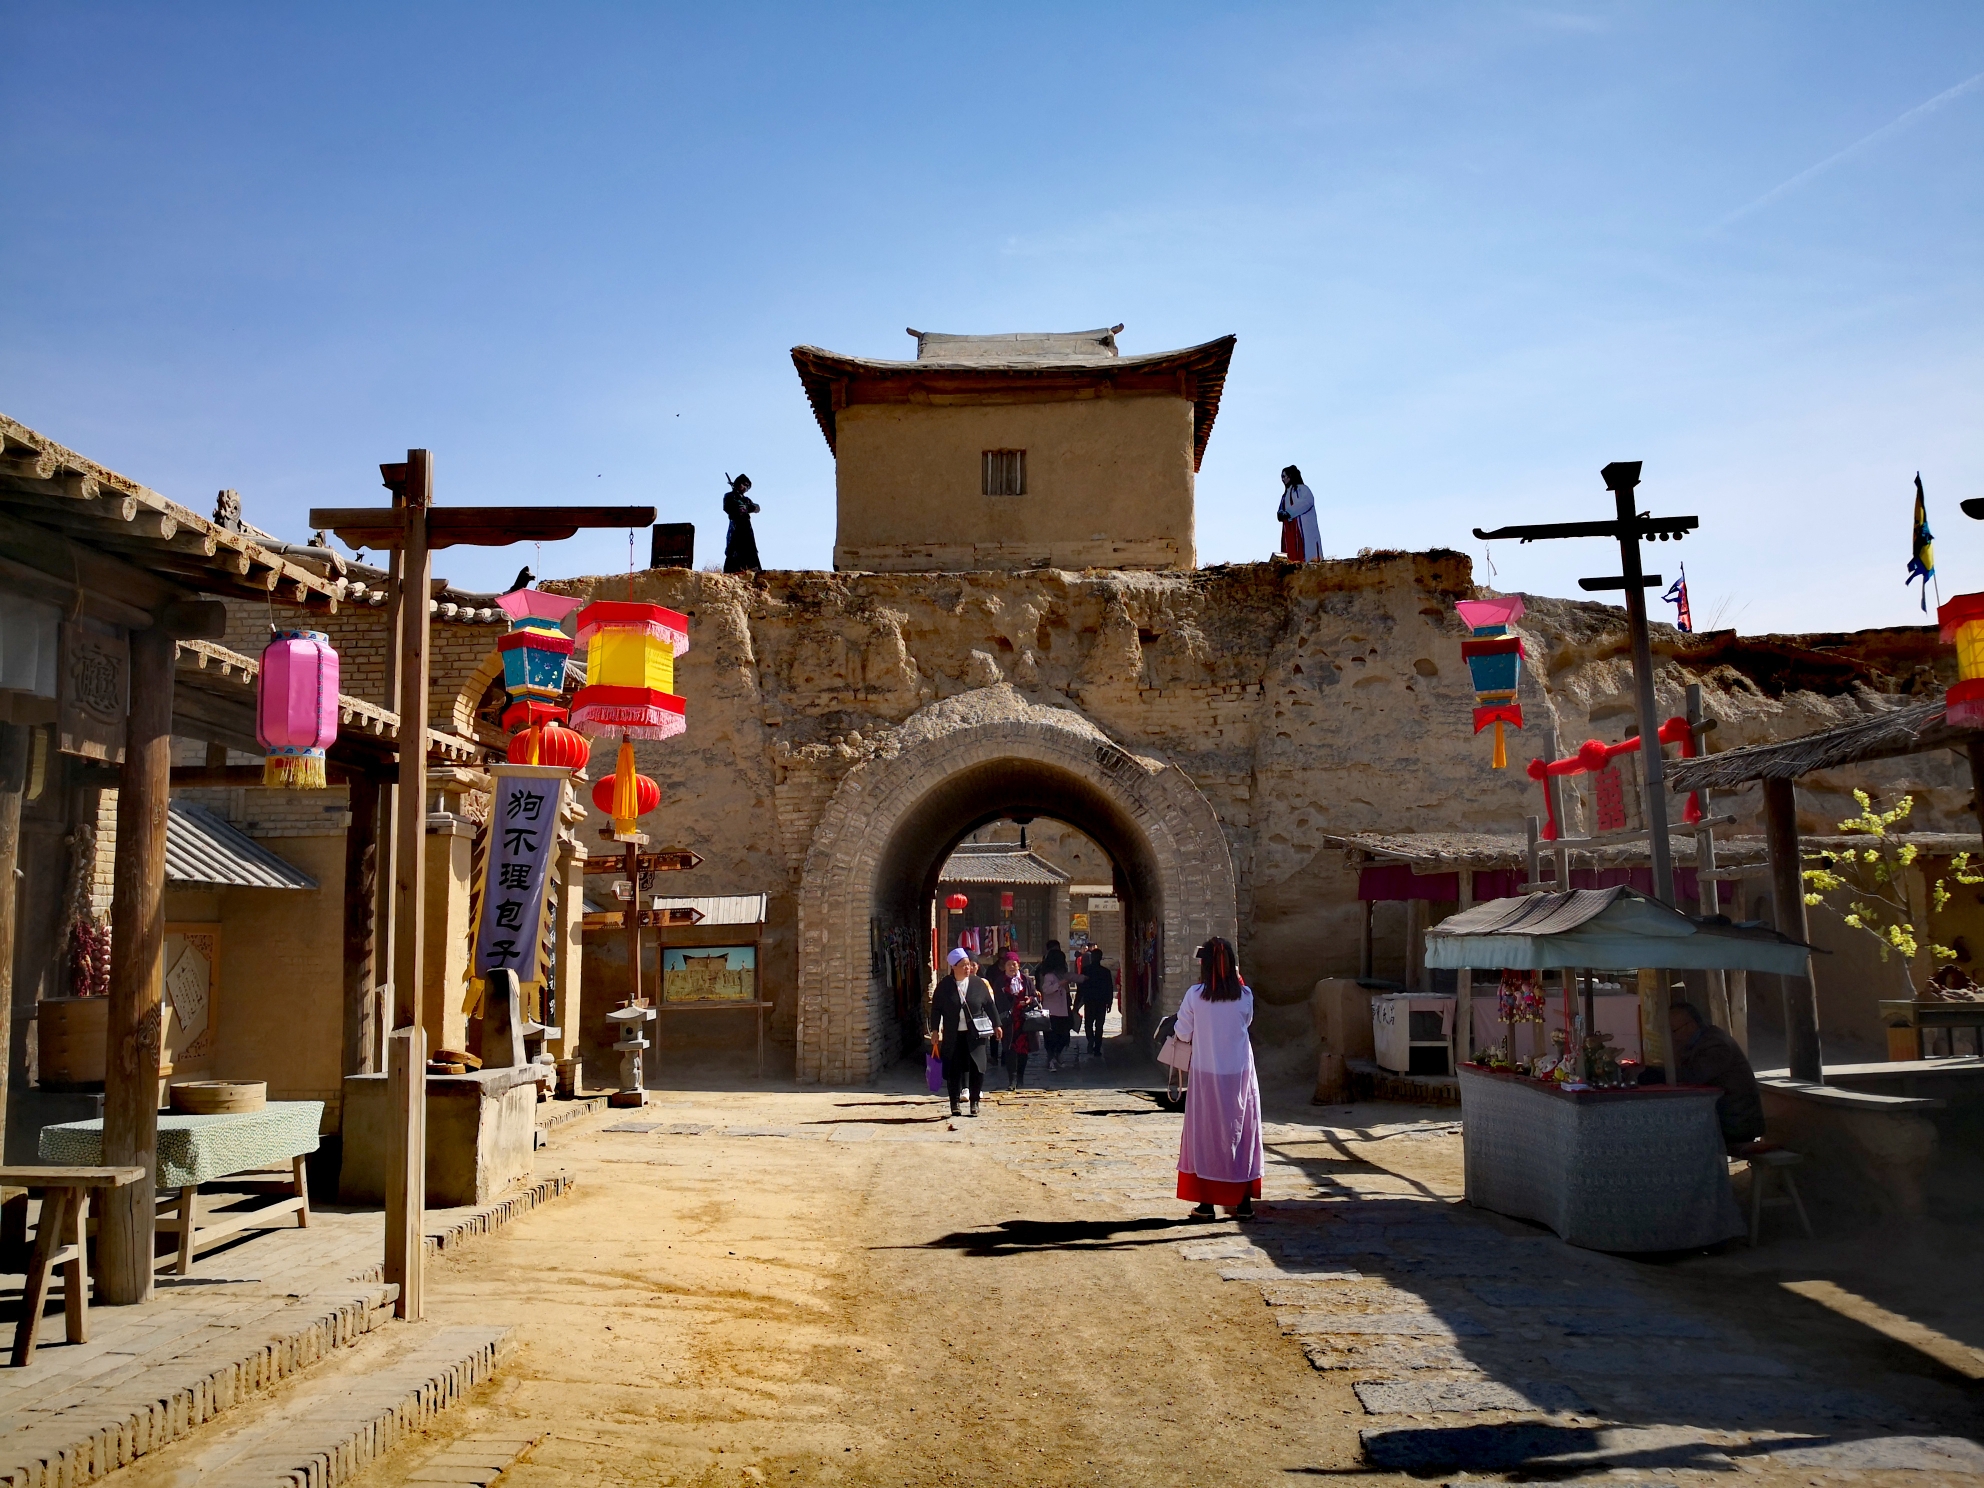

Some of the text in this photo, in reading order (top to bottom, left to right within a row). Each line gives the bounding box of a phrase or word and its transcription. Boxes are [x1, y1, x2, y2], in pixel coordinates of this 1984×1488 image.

[486, 789, 545, 969] 狗不理包子
